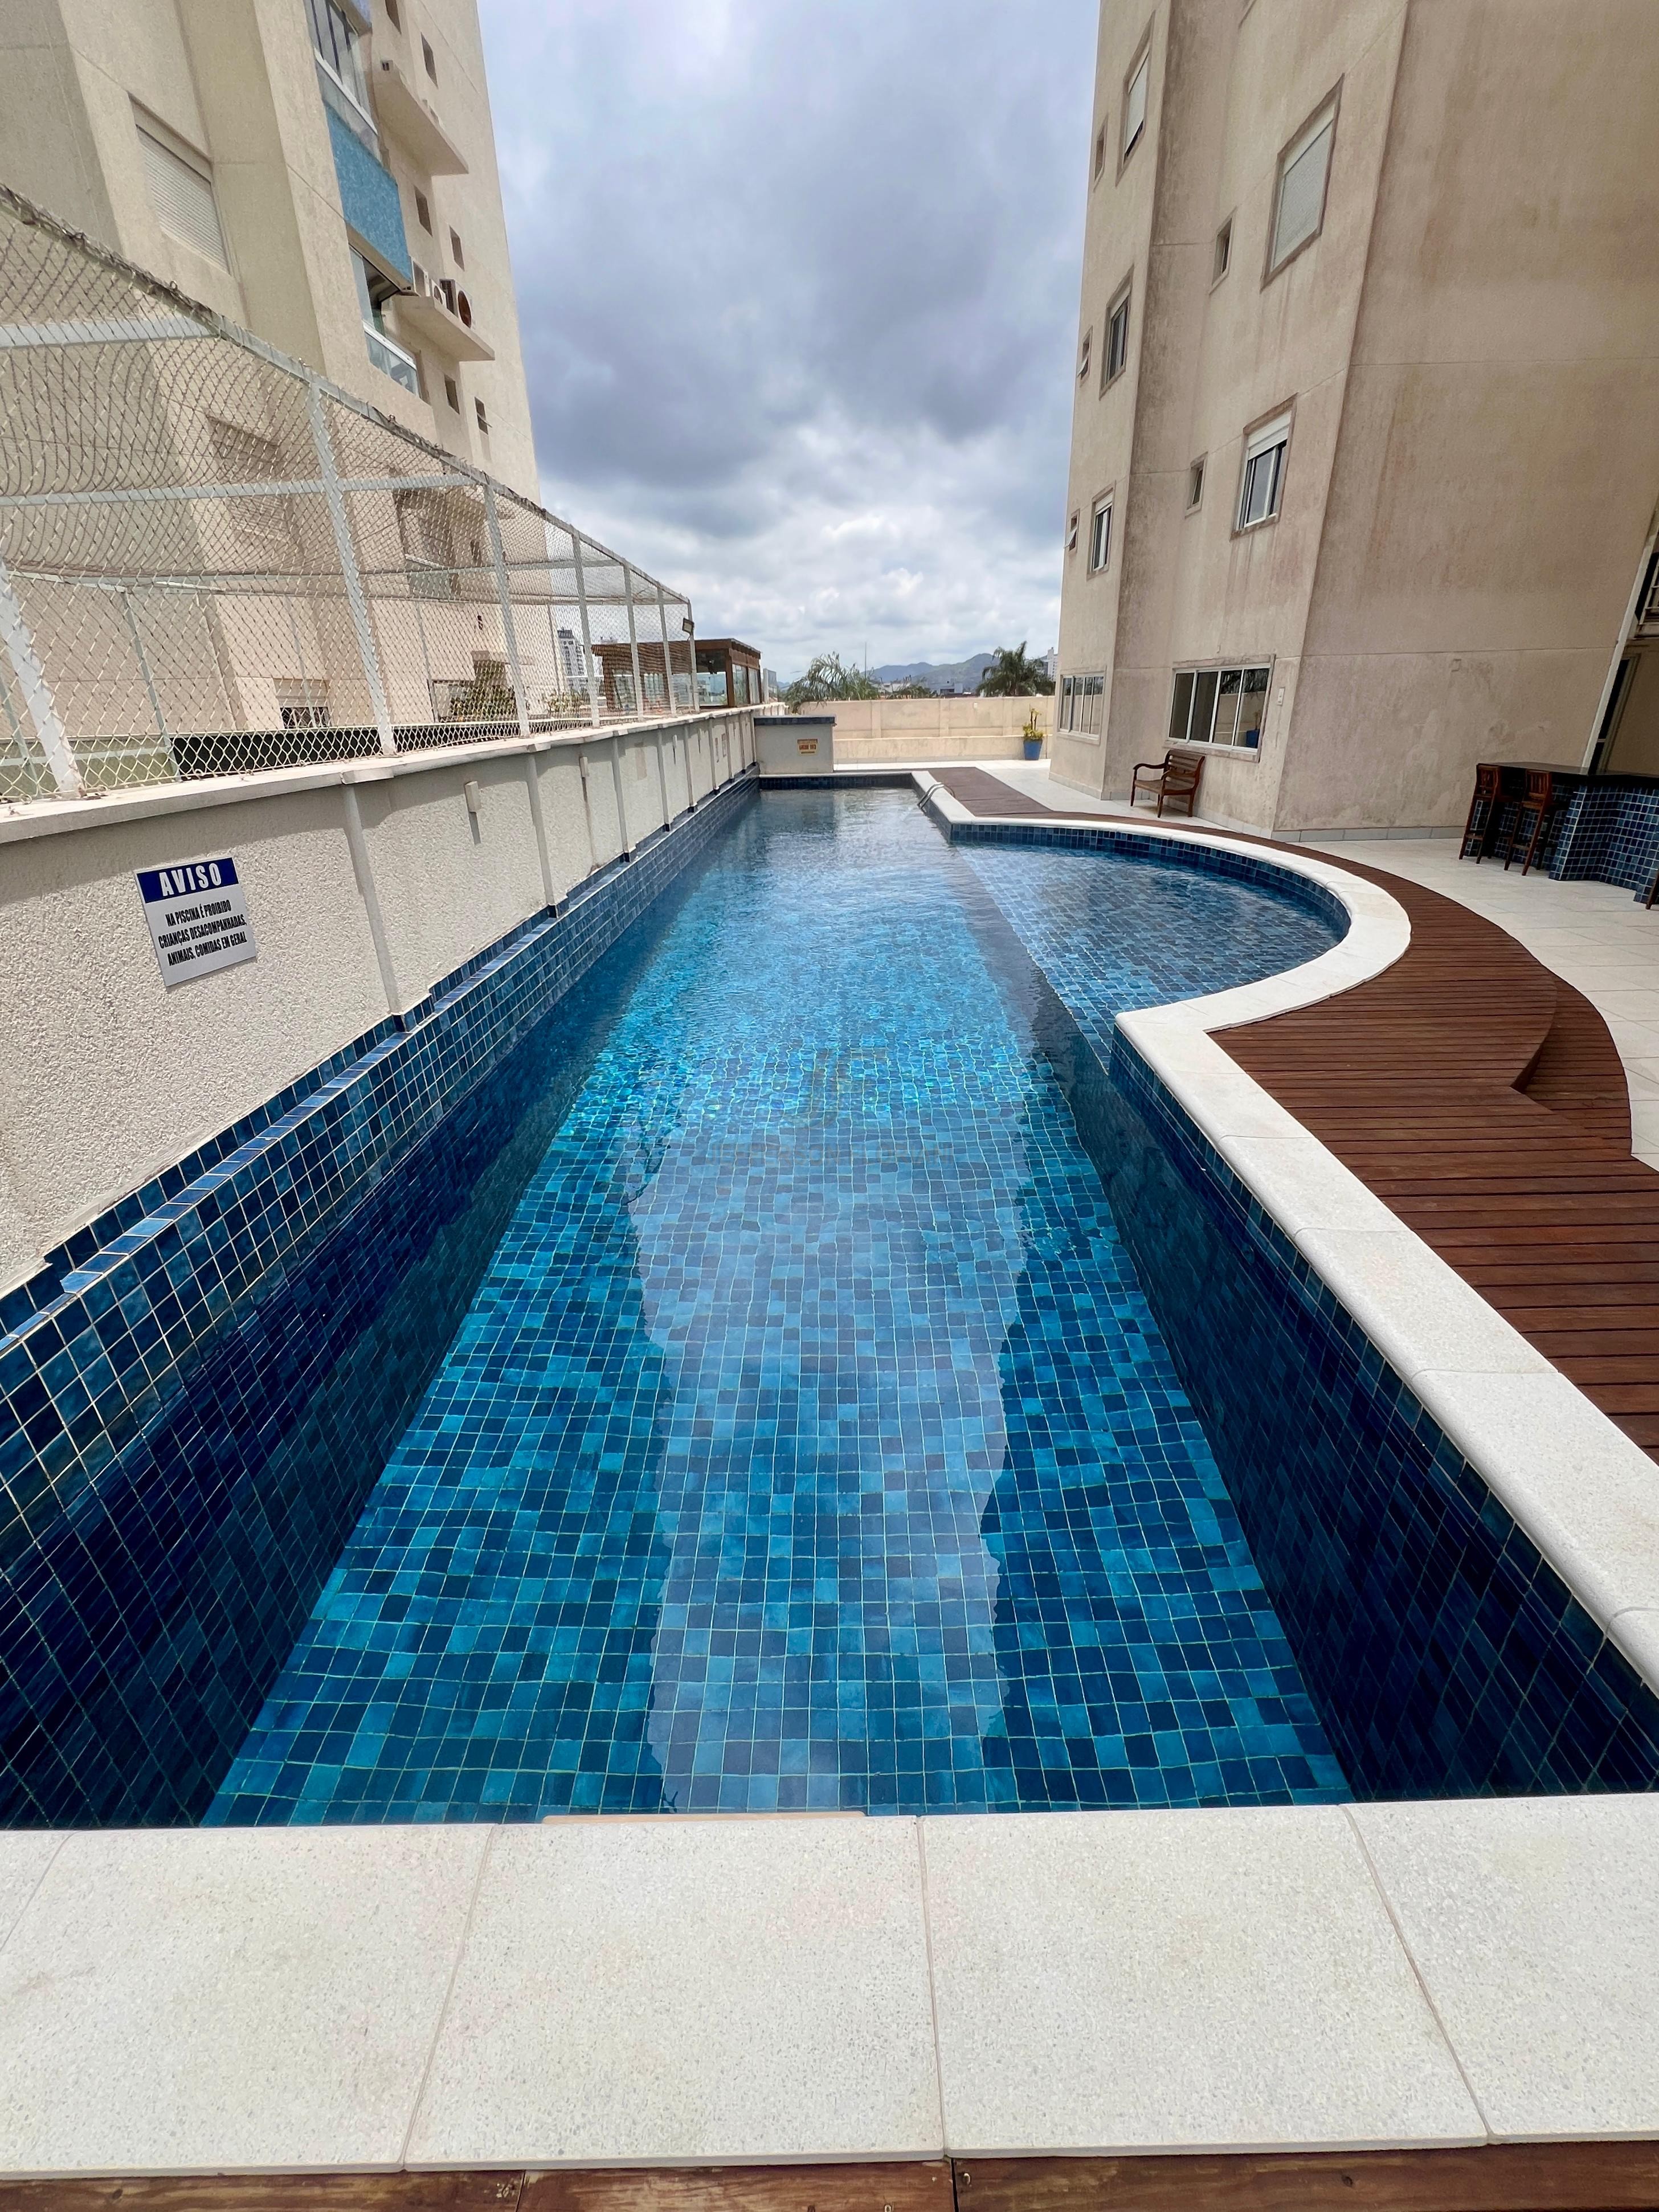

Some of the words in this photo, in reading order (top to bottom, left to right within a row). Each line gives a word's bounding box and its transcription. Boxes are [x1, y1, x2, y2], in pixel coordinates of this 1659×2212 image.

[159, 862, 222, 897] AVISO
[165, 913, 176, 927] NA
[175, 907, 201, 925] PISCINA
[199, 903, 205, 918] É
[203, 899, 231, 917] PROIBIDO
[158, 929, 190, 949] CRIANÇAS
[195, 938, 222, 957] COMIDAS
[221, 936, 231, 949] EM
[230, 931, 247, 947] GERAL
